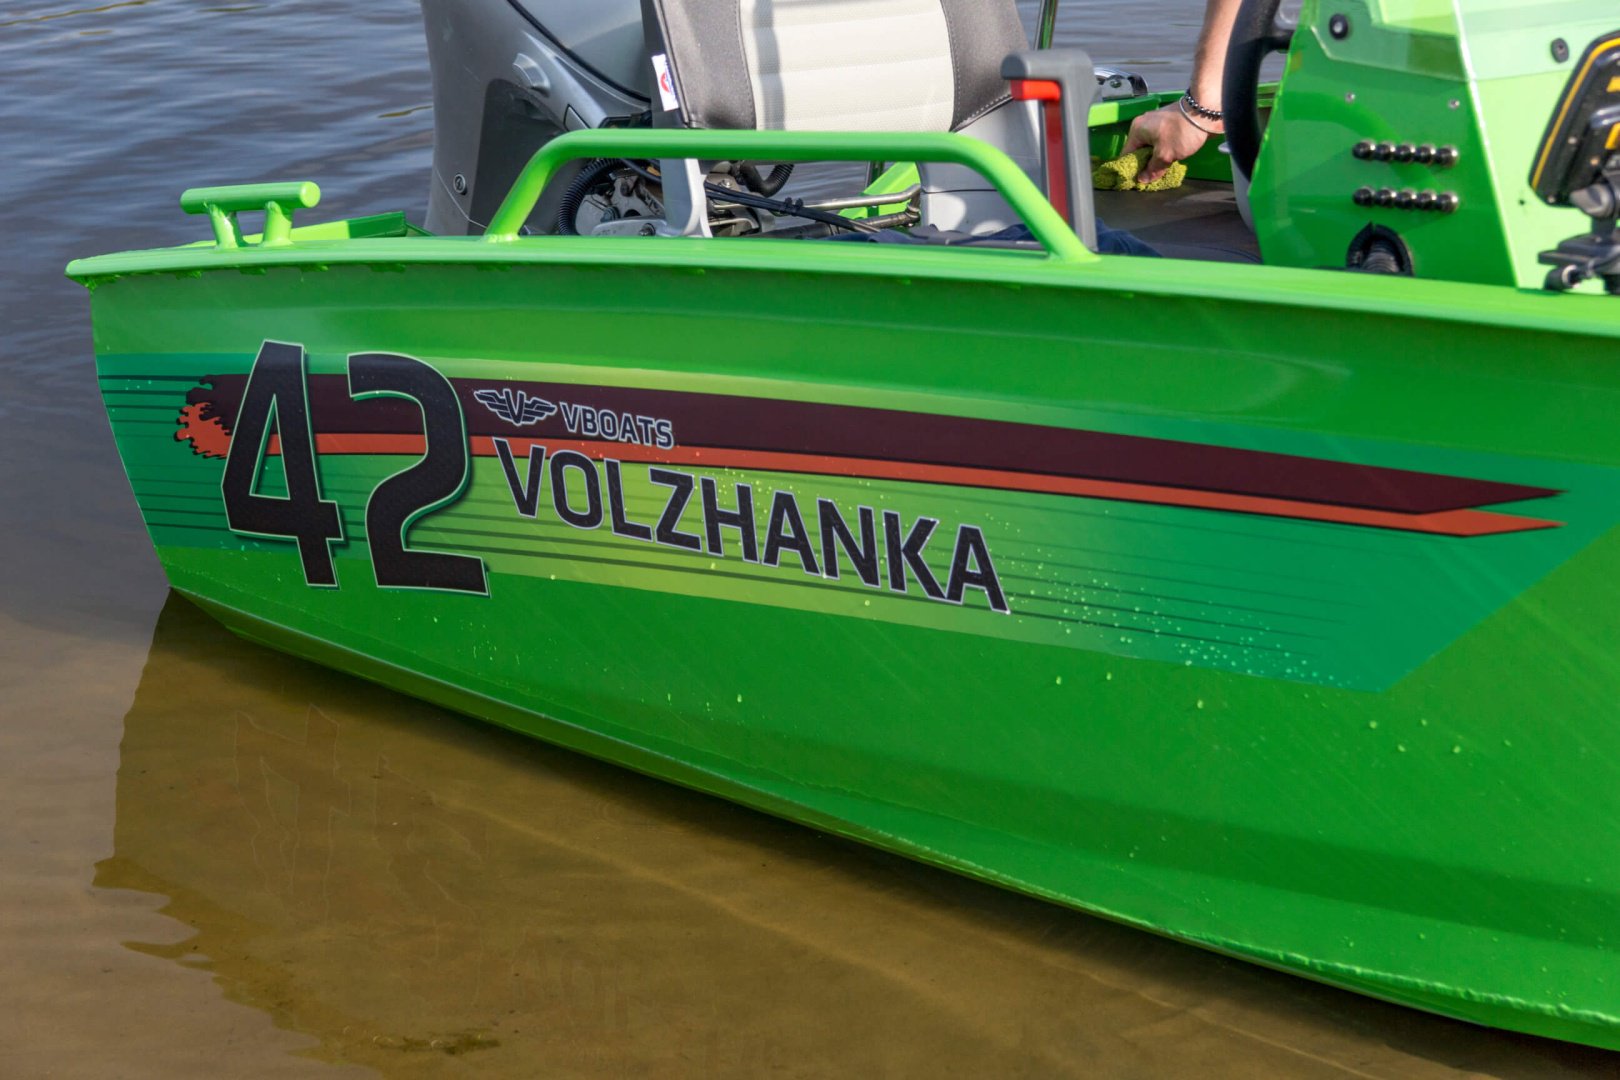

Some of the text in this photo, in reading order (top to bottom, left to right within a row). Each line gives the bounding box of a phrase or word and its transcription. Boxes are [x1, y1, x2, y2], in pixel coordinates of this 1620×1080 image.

[221, 339, 489, 597] 42
[560, 402, 674, 449] VBOATS
[493, 438, 1010, 614] VOLZHANKA
